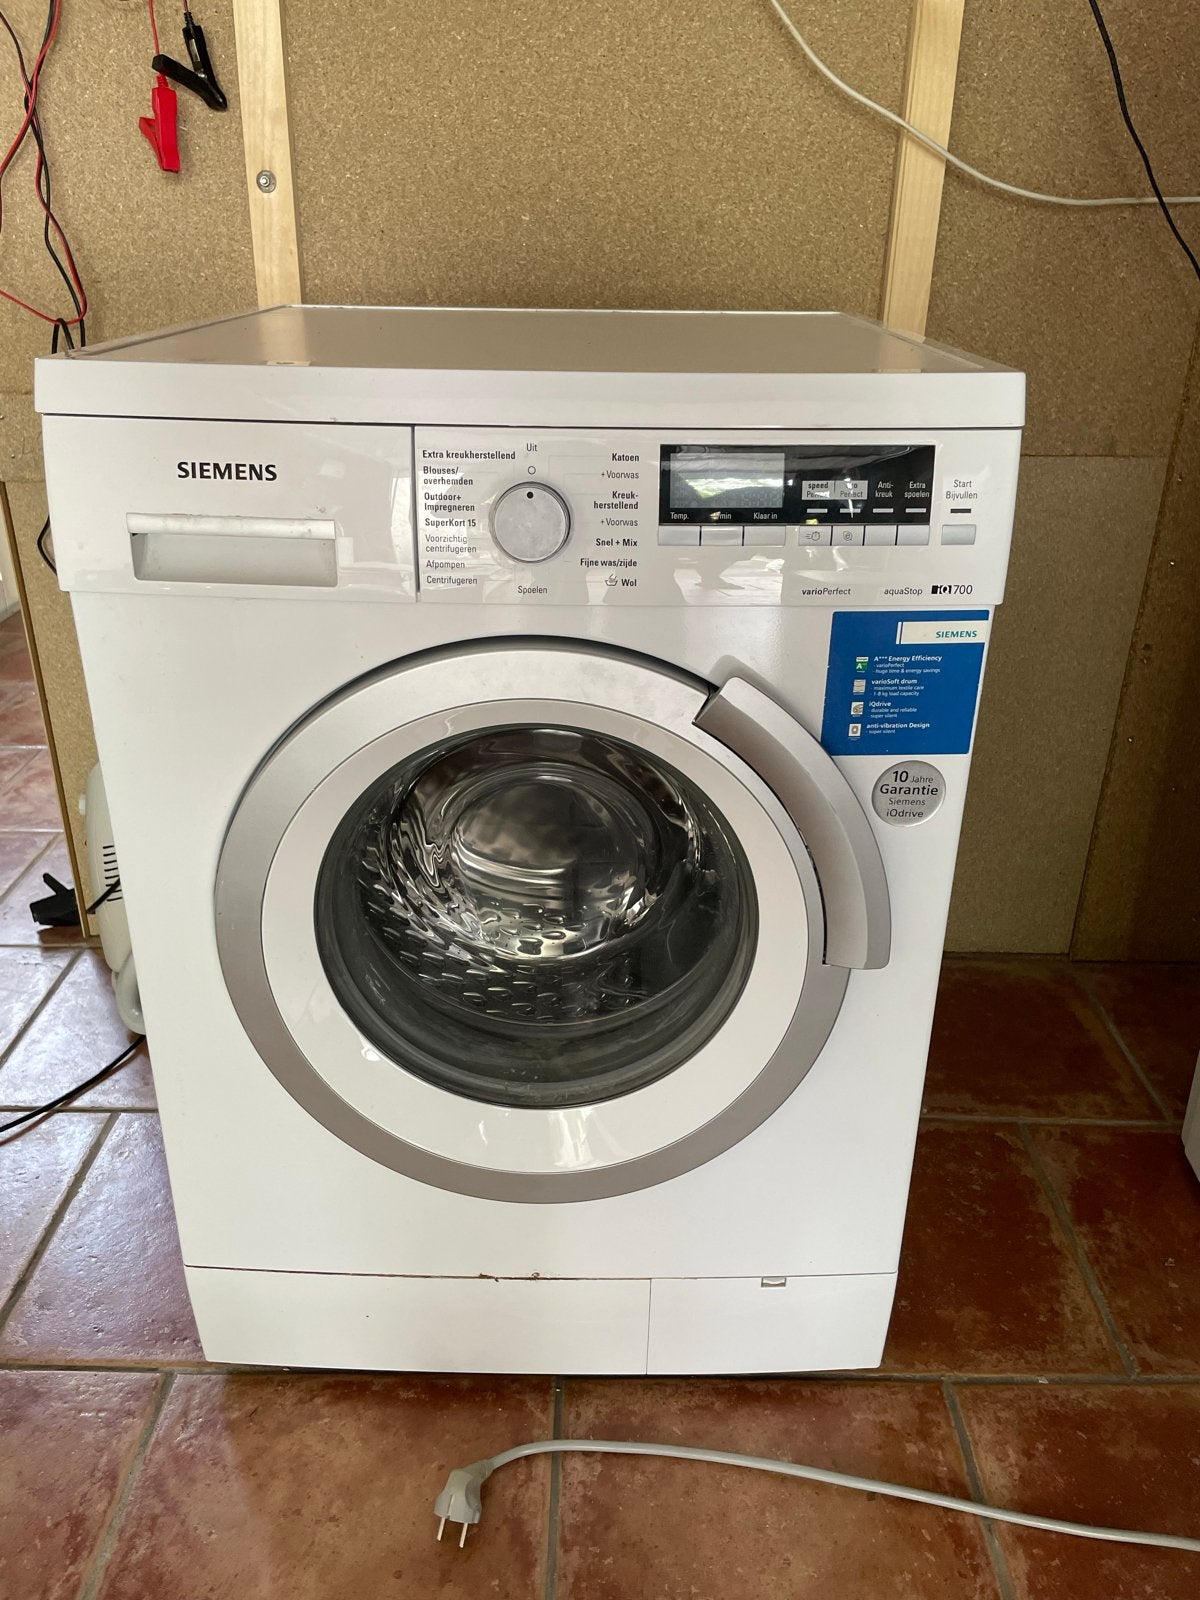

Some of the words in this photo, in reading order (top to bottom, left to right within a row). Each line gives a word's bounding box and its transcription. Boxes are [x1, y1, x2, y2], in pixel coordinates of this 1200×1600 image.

[527, 444, 537, 452] Uit
[422, 450, 444, 459] Extra
[446, 451, 516, 460] kreukherstellend
[612, 453, 640, 462] Katoen
[177, 462, 278, 482] SIEMENS
[423, 467, 459, 475] Blouses/
[423, 477, 473, 486] overhemden
[808, 482, 829, 490] speed
[954, 480, 972, 489] Start
[424, 493, 462, 501] Outdoor+
[612, 491, 639, 500] Kreuk-
[946, 490, 977, 501] Bijvullen
[425, 503, 475, 512] Impregneren
[594, 501, 639, 510] herstellend
[670, 512, 689, 520] Temp.
[425, 519, 466, 528] SuperKort
[468, 519, 476, 527] 15
[425, 535, 468, 544] Voorzichtig
[596, 538, 614, 547] Snel
[622, 539, 638, 547] Mix
[425, 545, 477, 554] centrifugeren
[426, 561, 465, 570] Afpompen
[580, 559, 599, 567] Fijne
[601, 559, 637, 568] was/zijde
[427, 576, 477, 586] Centrifugeren
[622, 579, 637, 587] Wol
[518, 586, 548, 595] Spoelen
[884, 588, 923, 596] aquaStop
[893, 771, 909, 783] 10
[911, 776, 933, 784] Jahre
[880, 785, 939, 795] Garantie
[889, 798, 926, 806] Siemens
